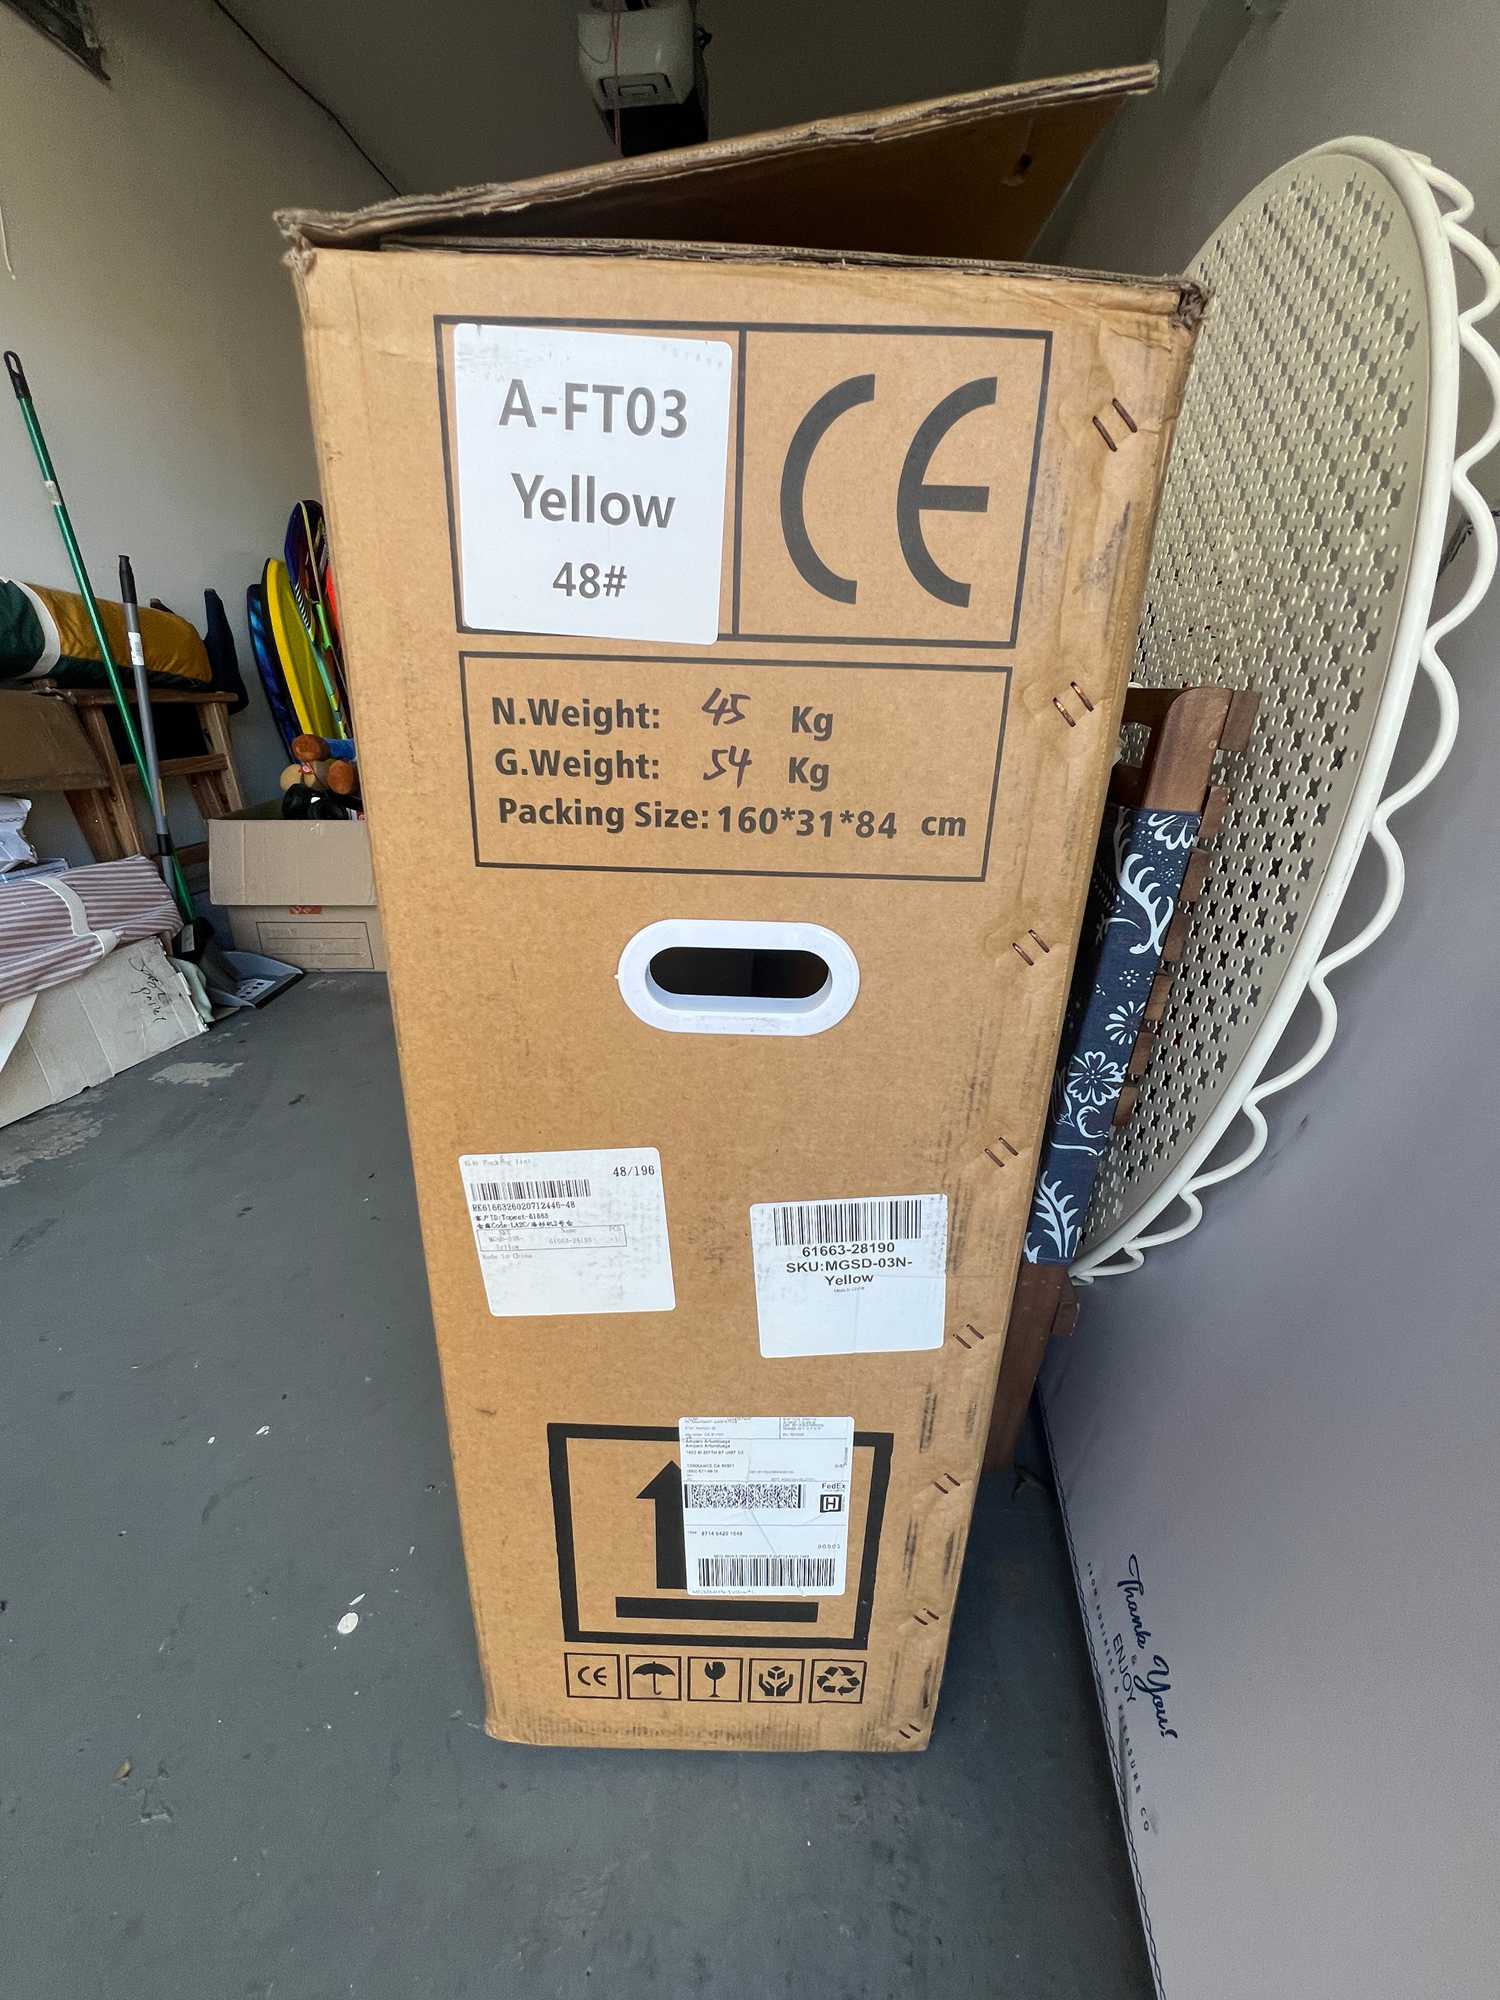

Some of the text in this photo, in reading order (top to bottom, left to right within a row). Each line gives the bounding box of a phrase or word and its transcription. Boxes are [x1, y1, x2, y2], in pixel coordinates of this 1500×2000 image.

[497, 378, 688, 439] A-FT03
[511, 472, 675, 529] Yellow
[552, 561, 628, 600] 48#
[491, 687, 834, 742] N.Weight: 45 Kg
[494, 746, 830, 793] G.Weight: 54 Kg
[498, 796, 626, 833] Packing
[634, 799, 710, 831] Size:
[920, 811, 968, 838] cm
[612, 1165, 656, 1178] 48/196
[786, 1257, 913, 1274] SKU:MGSD-03N-
[802, 1241, 896, 1258] 61663-28190
[825, 1274, 875, 1287] Yellow
[821, 1482, 847, 1490] FedEx
[1116, 1553, 1178, 1739] Thank You!
[1112, 1633, 1136, 1703] ENJOY
[1140, 1806, 1151, 1832] CO
